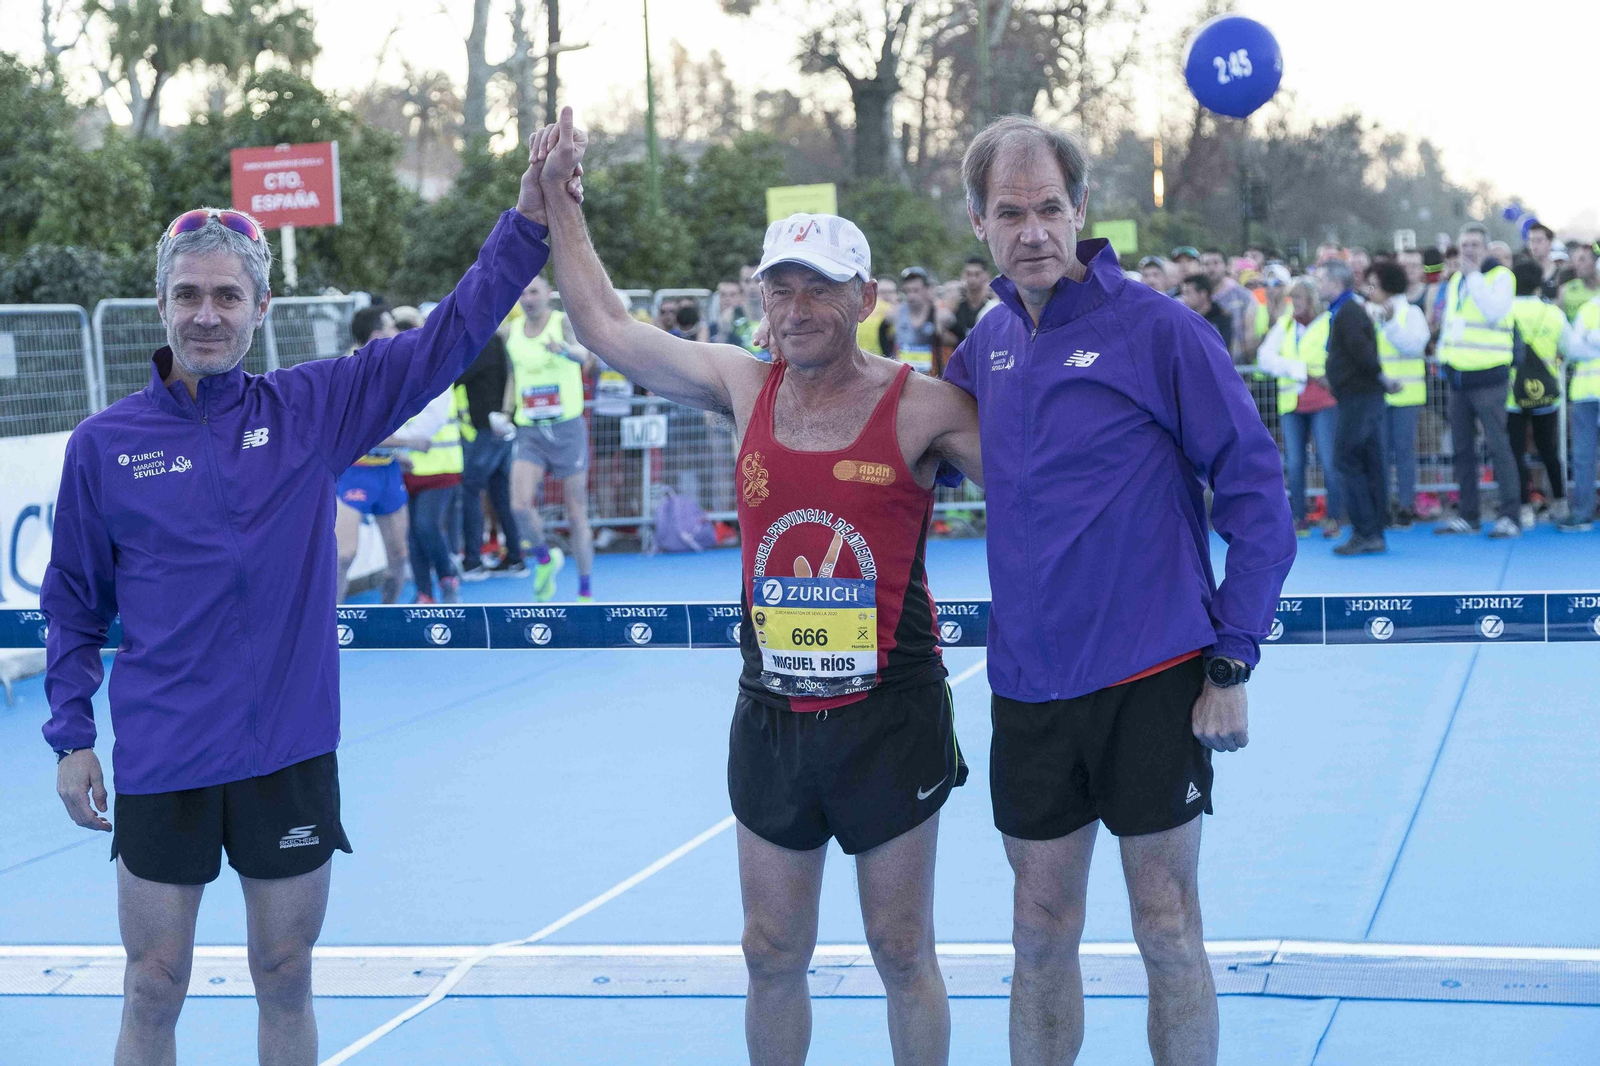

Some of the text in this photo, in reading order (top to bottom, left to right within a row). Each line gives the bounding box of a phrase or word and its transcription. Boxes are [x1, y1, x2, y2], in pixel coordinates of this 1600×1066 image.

[251, 189, 320, 212] ESPAÑA
[131, 450, 164, 463] ZURICH
[133, 460, 165, 472] MARATÓN
[134, 467, 166, 480] SEVILLA
[860, 475, 886, 484] SPORT
[753, 508, 877, 580] ESCUELA PROVINCIAL DE ATLETISMO
[787, 586, 858, 602] ZURICH
[1352, 599, 1413, 611] ZURICH
[1462, 597, 1524, 609] ZURICH
[410, 609, 466, 618] ZURICH
[511, 608, 567, 618] ZURICH
[611, 607, 668, 617] ZURICH
[791, 627, 828, 646] 666
[772, 654, 856, 672] MIGUEL RÍOS
[845, 685, 872, 694] ZURICH
[279, 836, 319, 846] SKECHERS
